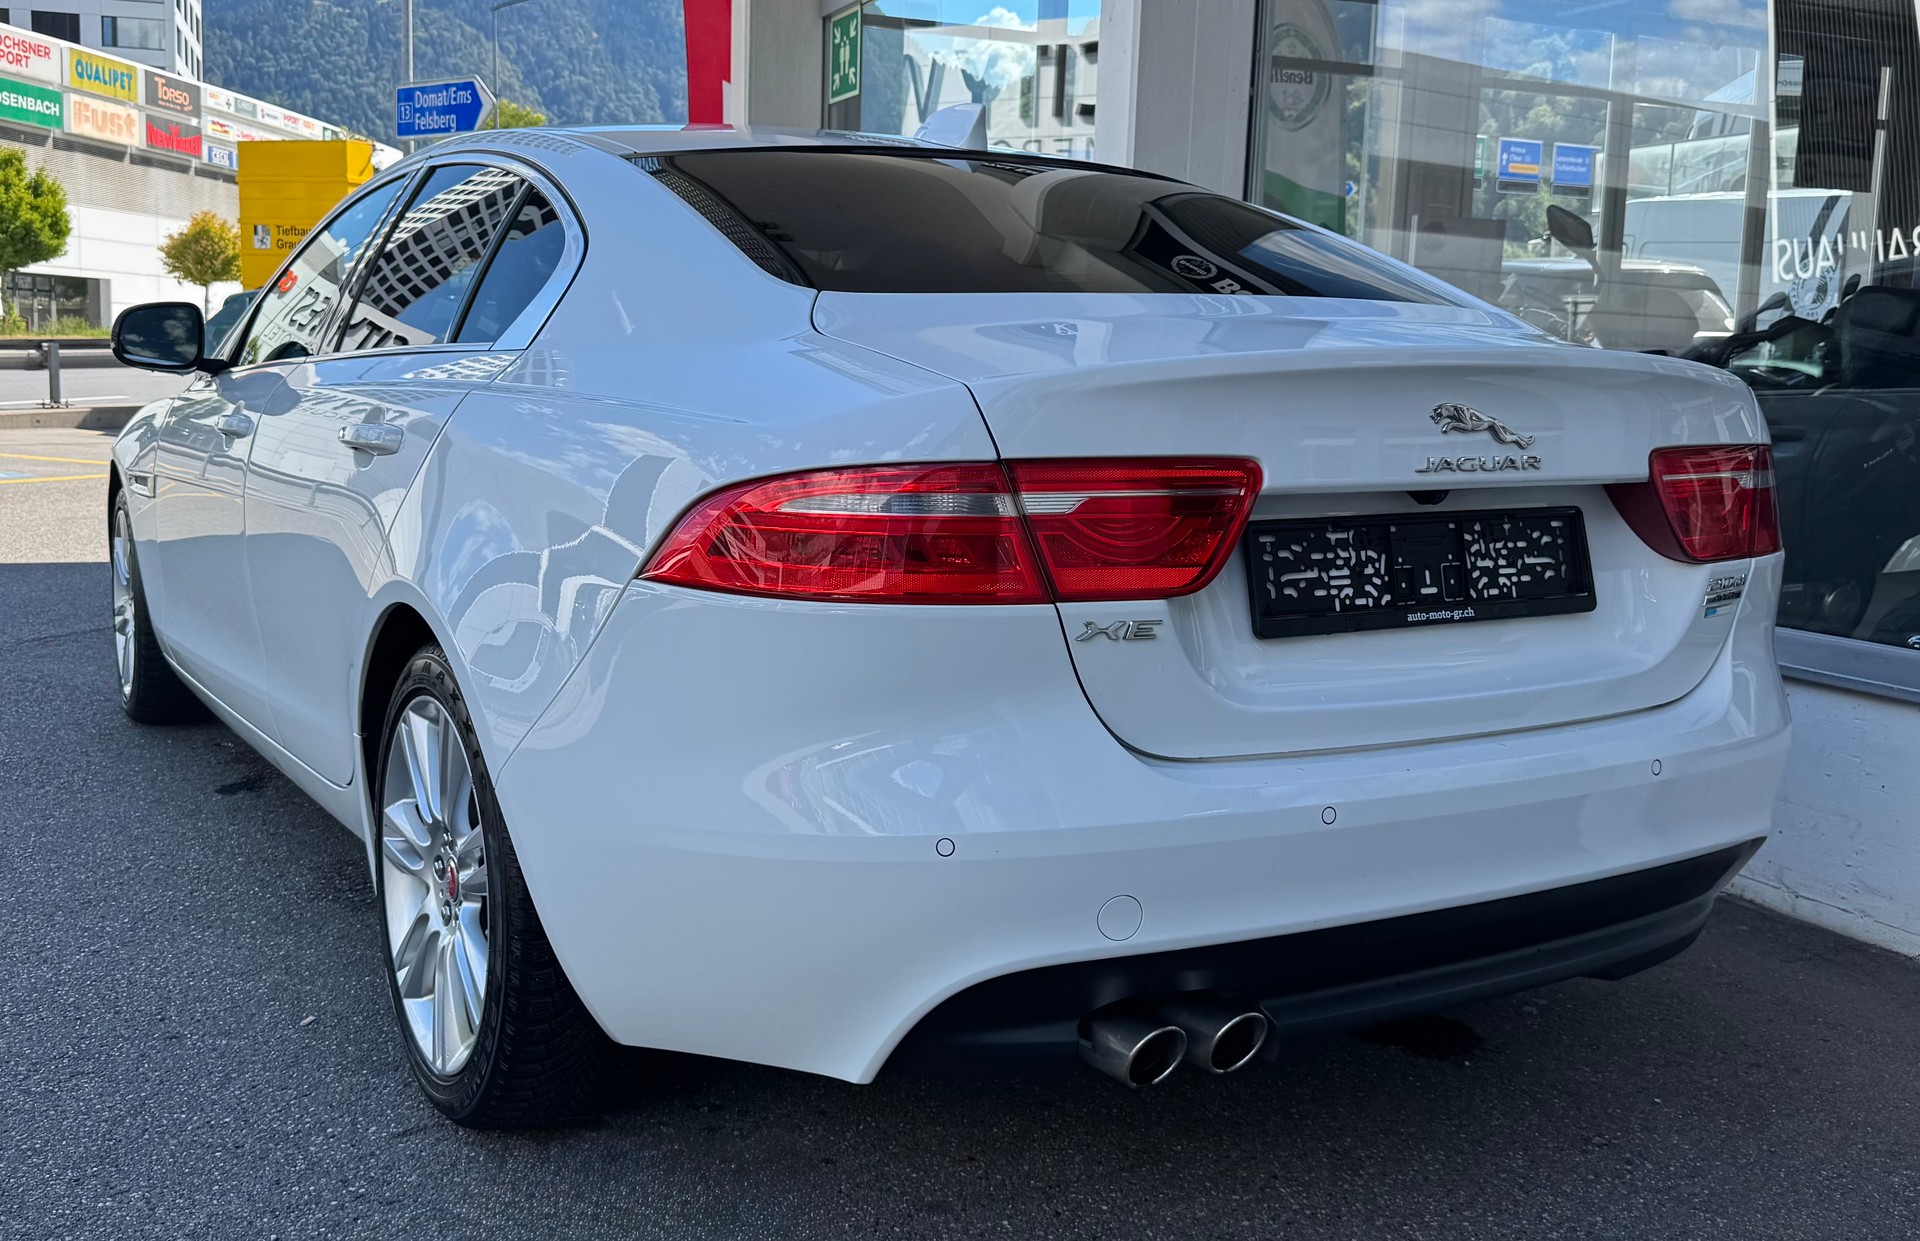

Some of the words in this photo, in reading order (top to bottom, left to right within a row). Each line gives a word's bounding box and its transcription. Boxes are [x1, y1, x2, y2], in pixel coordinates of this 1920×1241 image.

[75, 58, 133, 92] QUALIPET
[415, 87, 472, 108] Domat/Ems
[400, 105, 411, 120] 13
[415, 111, 457, 132] Felsberg
[1415, 455, 1541, 473] JAGUAR
[1407, 607, 1475, 621] auto-moto-gr.ch
[1075, 620, 1163, 641] XE
